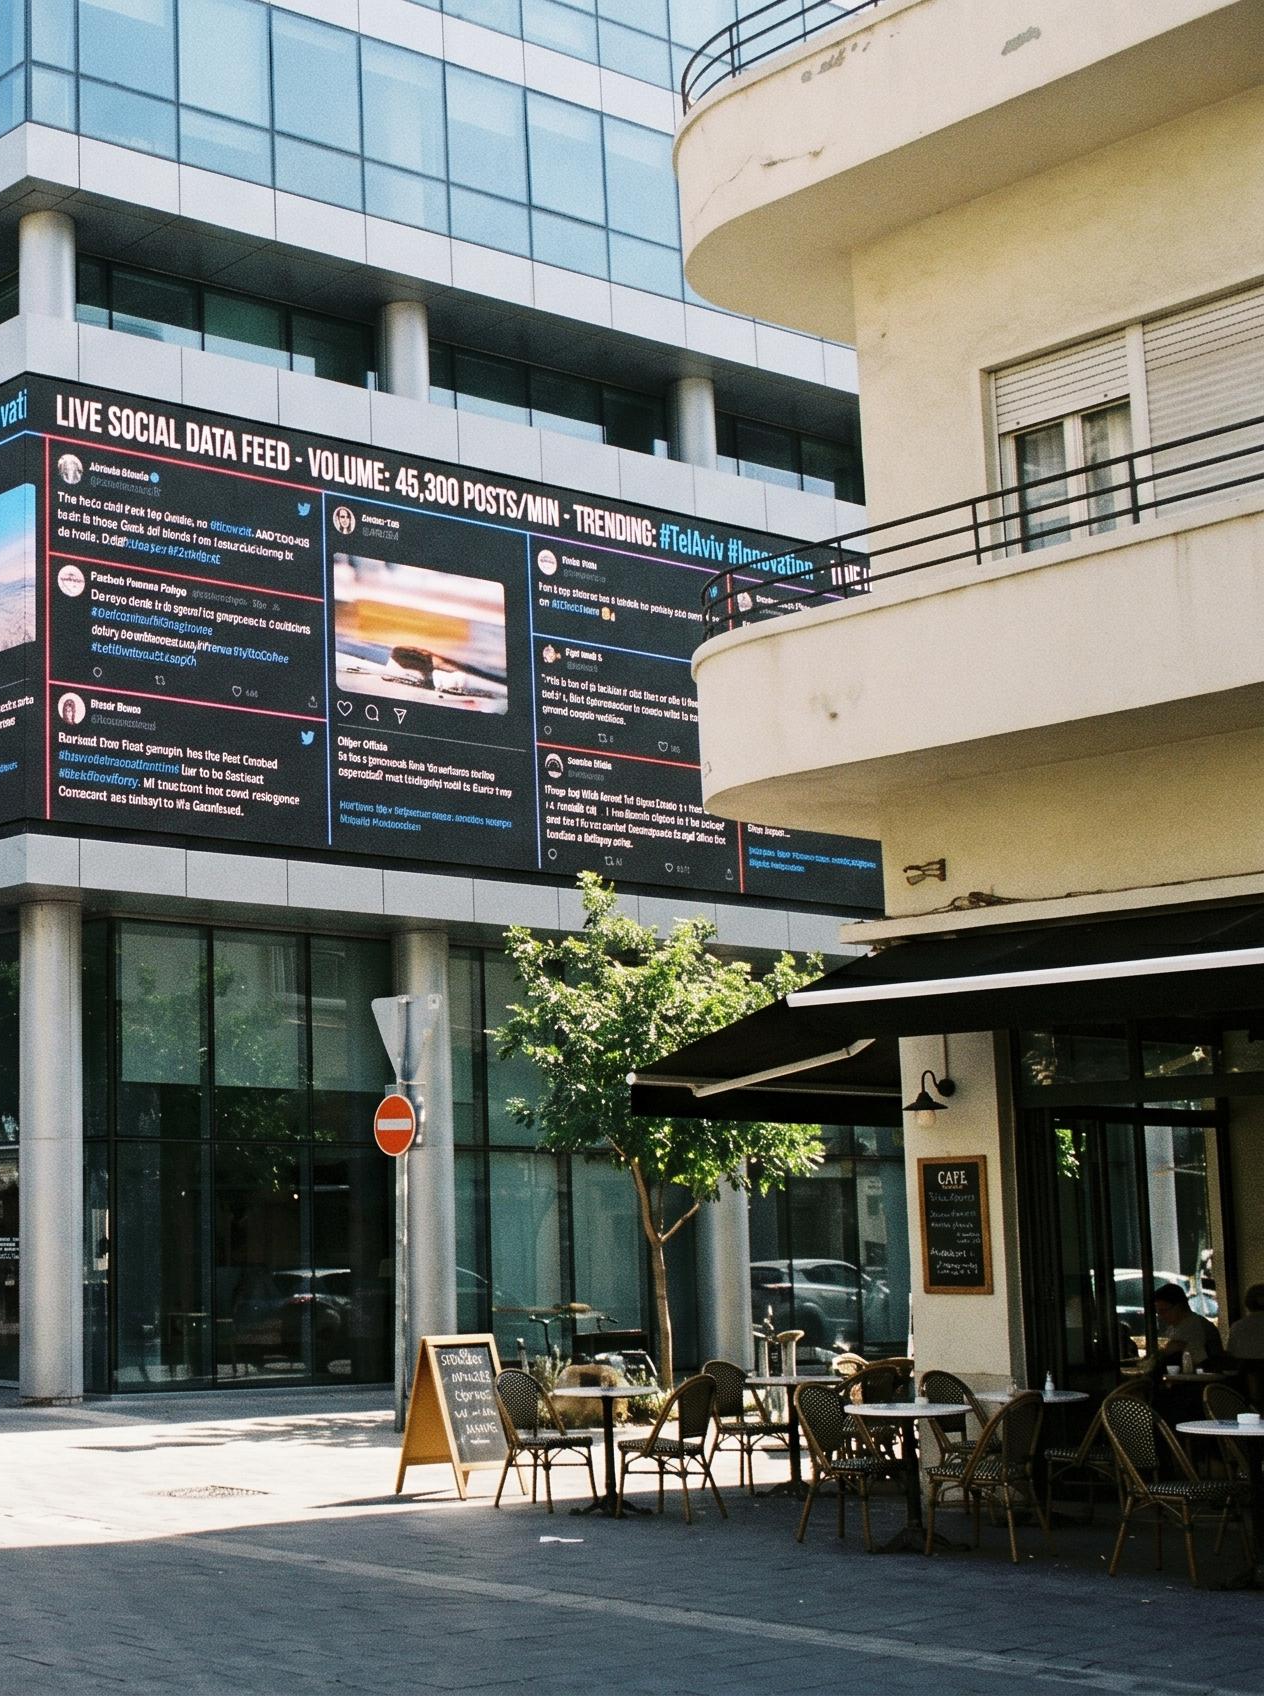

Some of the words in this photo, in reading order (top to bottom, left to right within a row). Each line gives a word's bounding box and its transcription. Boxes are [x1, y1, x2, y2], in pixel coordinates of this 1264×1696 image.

[56, 394, 102, 434] LIVE
[108, 405, 181, 450] SOCIAL
[187, 421, 237, 461] DATA
[241, 433, 290, 471] FEED
[308, 447, 390, 493] VOLUME:
[395, 467, 458, 507] 45,300
[463, 481, 560, 528] POSTS/MIN
[573, 504, 657, 548] TRENDING:
[660, 523, 724, 561] #TelAviv
[57, 491, 77, 504] The
[93, 516, 118, 529] those
[199, 768, 210, 778] to
[938, 1170, 968, 1185] CAFE
